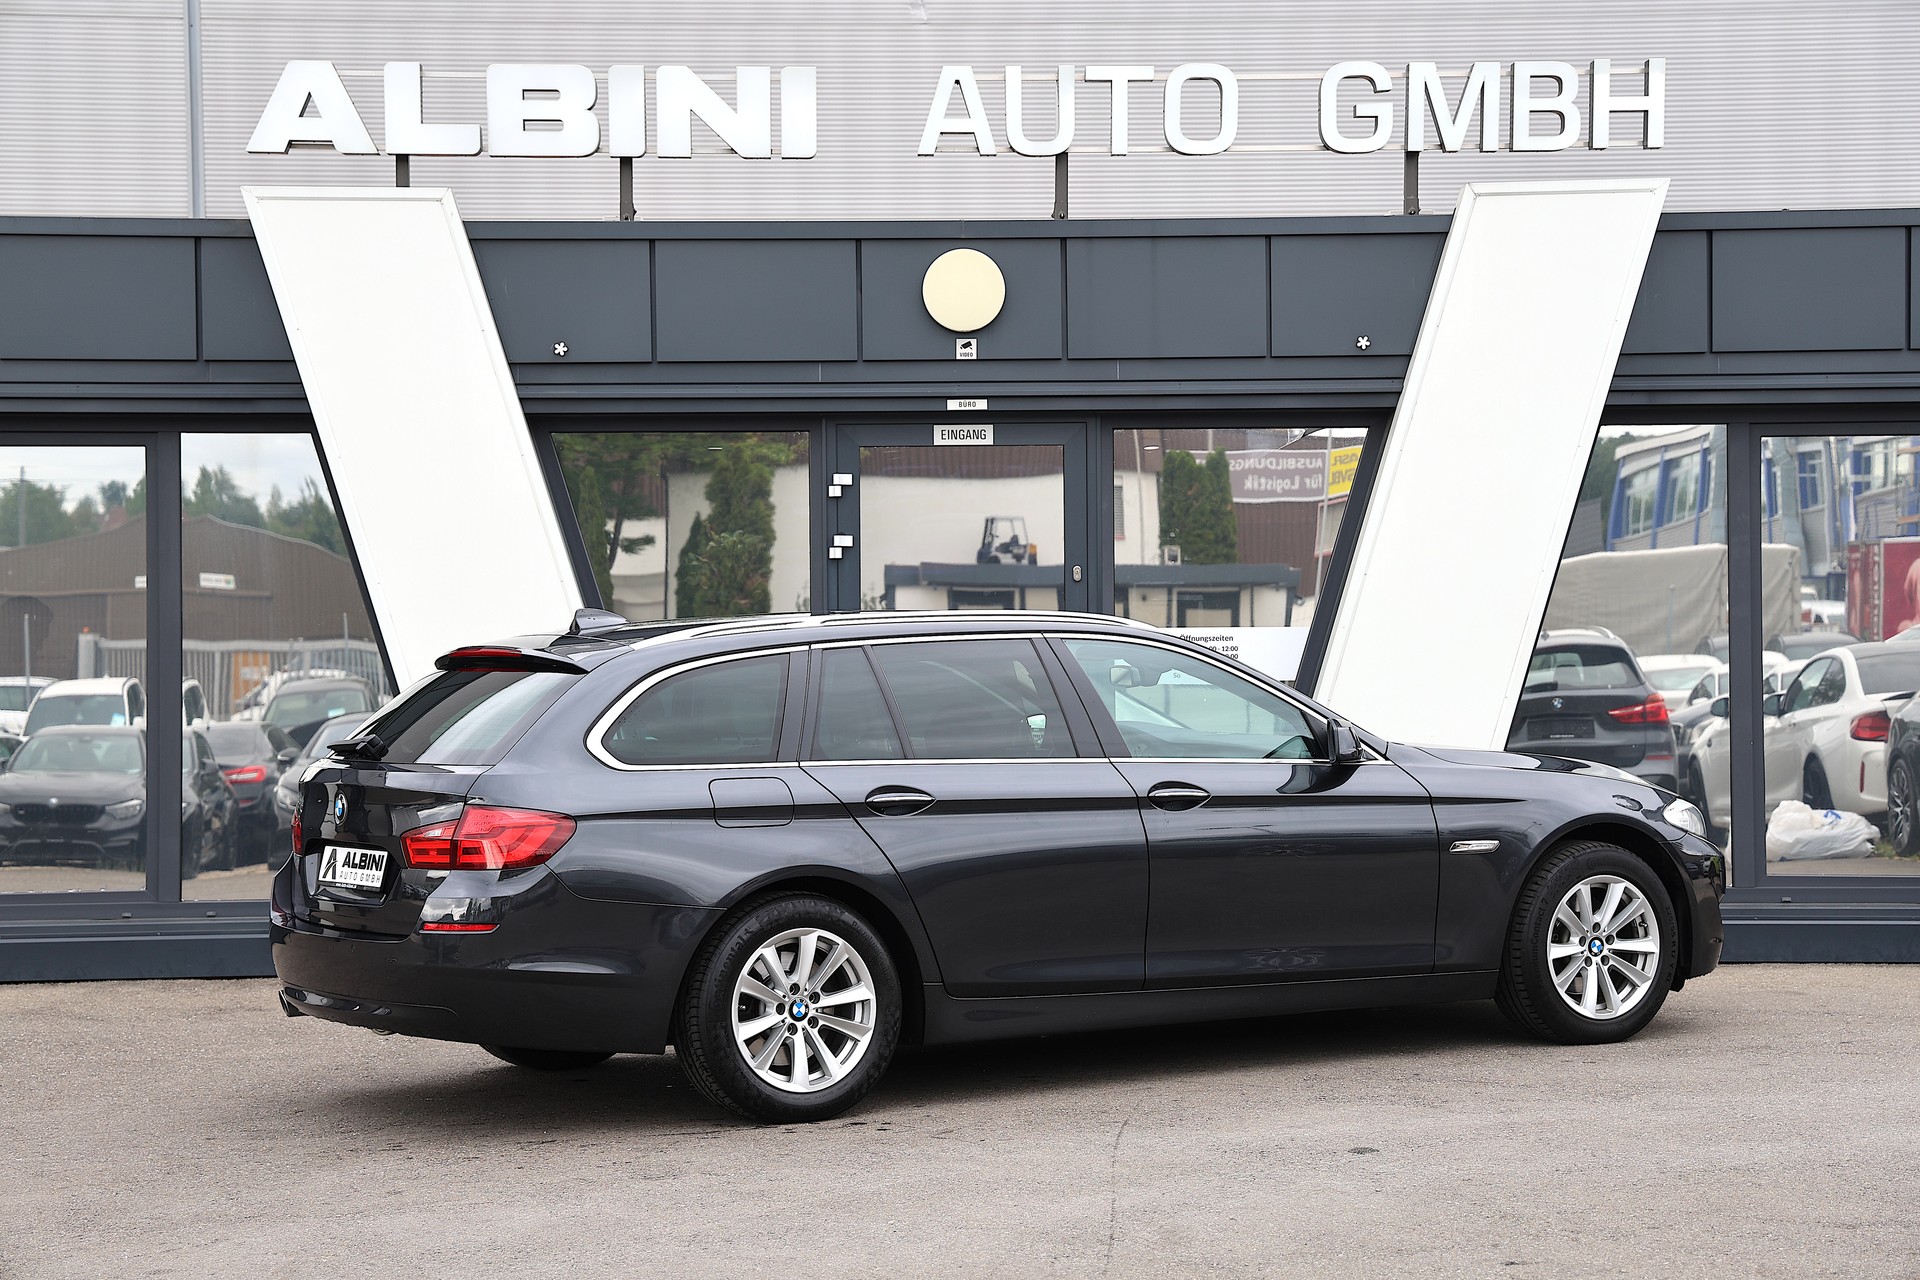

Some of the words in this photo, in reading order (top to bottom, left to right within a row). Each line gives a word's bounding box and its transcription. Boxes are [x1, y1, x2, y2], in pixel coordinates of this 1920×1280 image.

[246, 60, 818, 160] ALBINI
[917, 63, 1240, 156] AUTO
[1318, 58, 1666, 154] GMBH
[958, 400, 977, 408] BÜRO
[940, 429, 988, 440] EINGANG
[342, 851, 385, 871] ALBINI
[339, 871, 358, 881] AUTO
[360, 873, 381, 883] GMBH
